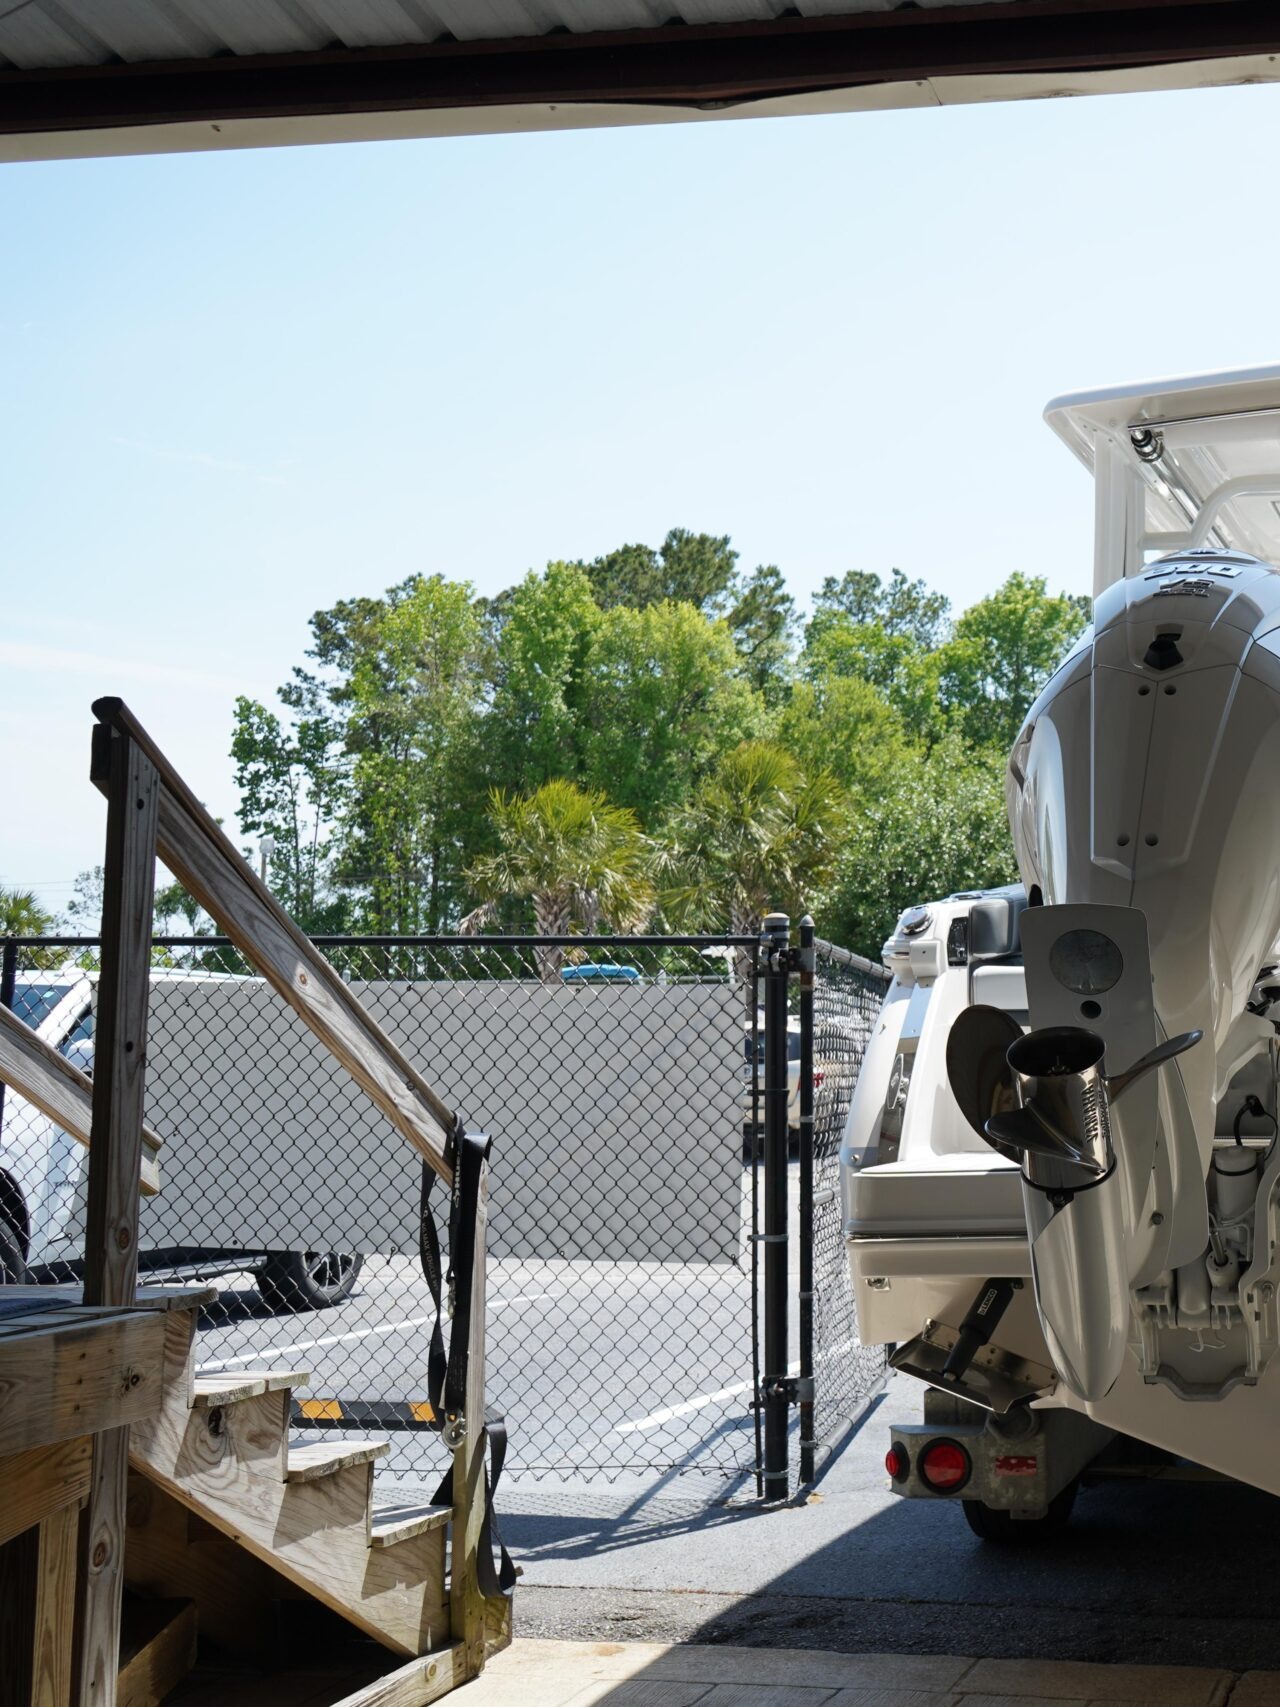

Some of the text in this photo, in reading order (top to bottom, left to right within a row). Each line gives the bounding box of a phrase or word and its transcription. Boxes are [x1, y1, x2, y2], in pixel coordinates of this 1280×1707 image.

[1144, 563, 1242, 580] 300
[1159, 577, 1215, 590] V6
[1080, 1082, 1099, 1143] YAMAHA
